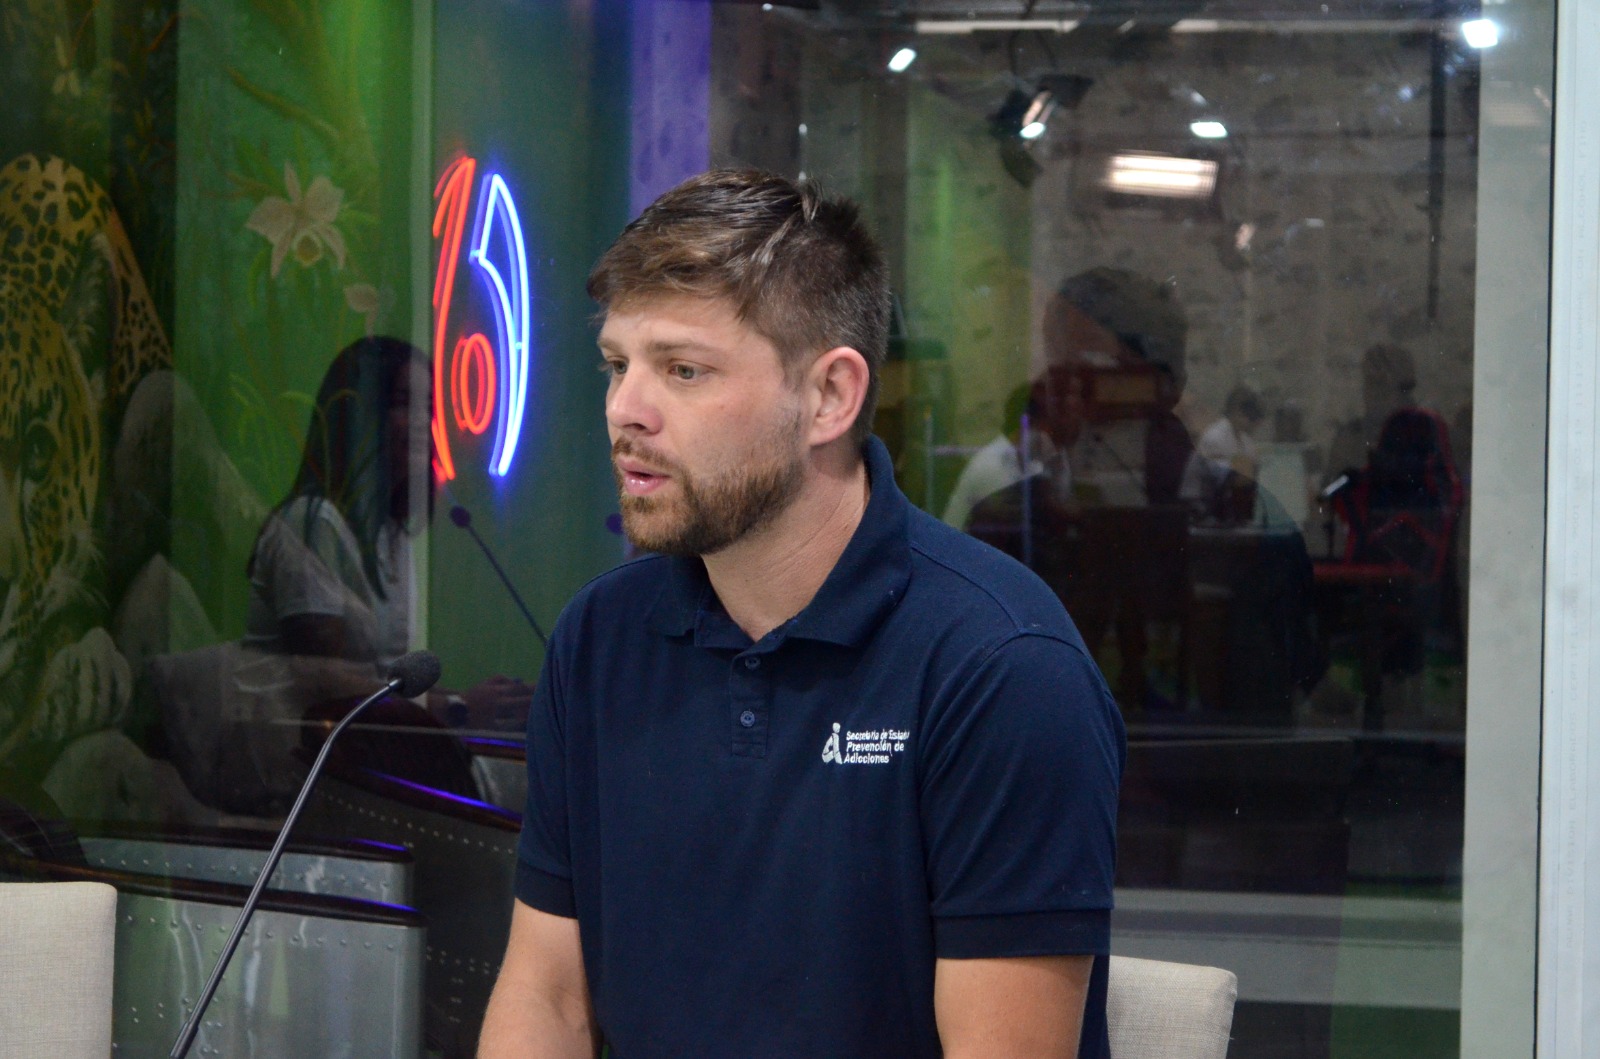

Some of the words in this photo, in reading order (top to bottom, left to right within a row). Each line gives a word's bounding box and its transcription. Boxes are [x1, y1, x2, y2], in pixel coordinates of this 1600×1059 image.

[1577, 168, 1586, 239] ALCOHOL
[843, 752, 890, 764] Adicciones
[846, 741, 891, 753] Prevención
[894, 741, 905, 752] de
[1568, 712, 1577, 810] ELABORADOS
[1566, 820, 1575, 895] DIVISION
